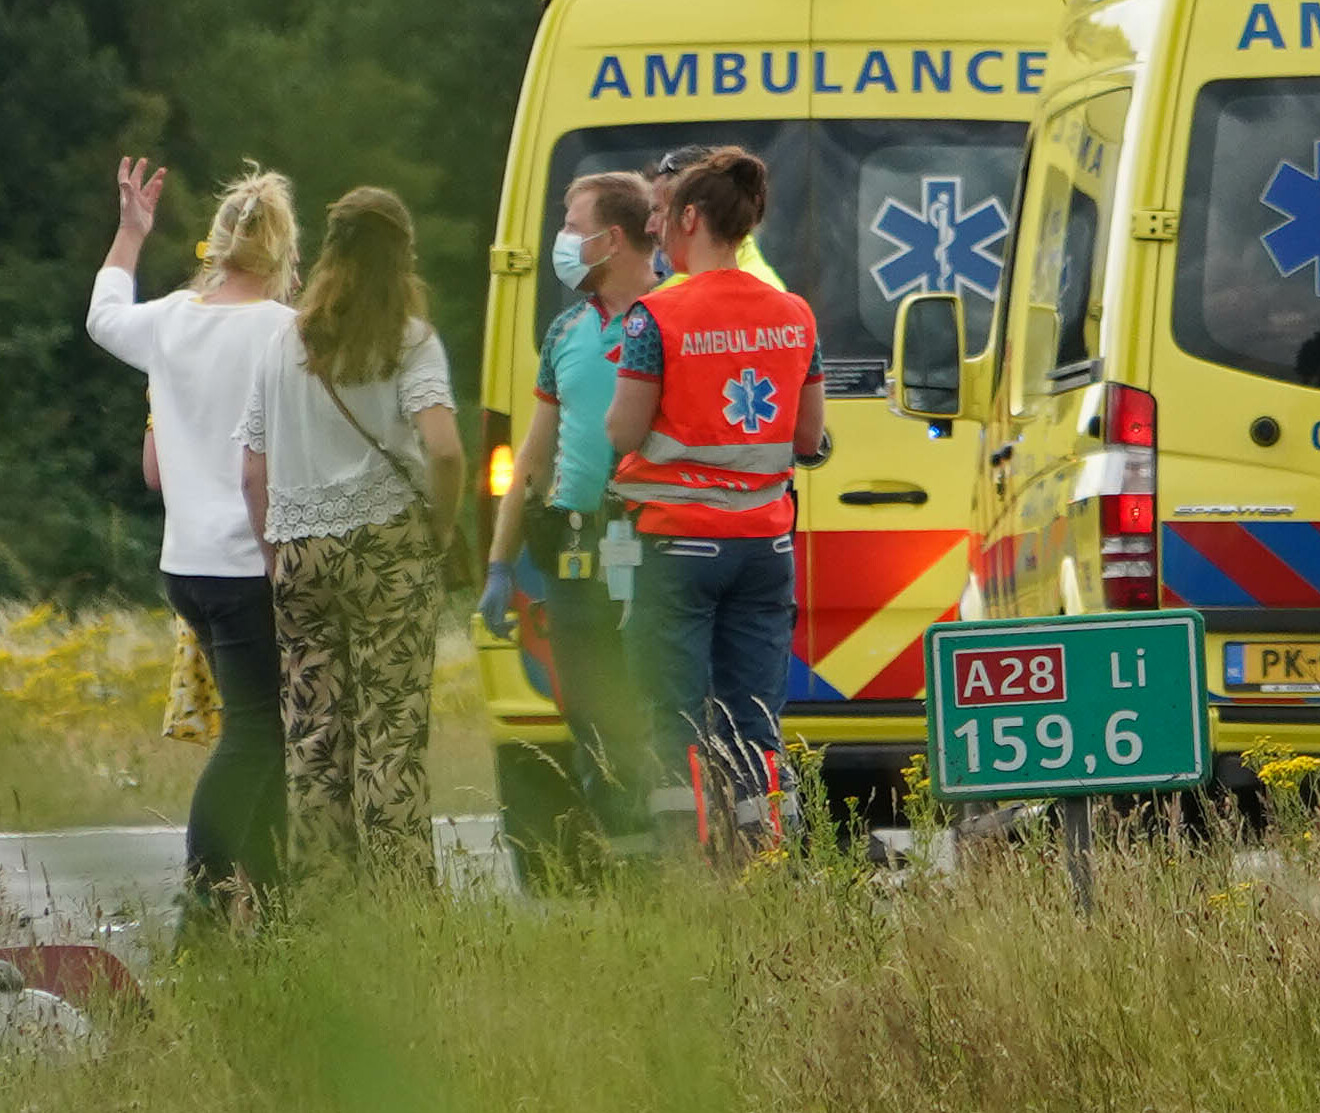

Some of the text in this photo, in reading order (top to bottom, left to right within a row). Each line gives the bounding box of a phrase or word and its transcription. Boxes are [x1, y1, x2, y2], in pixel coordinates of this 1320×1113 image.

[588, 49, 1048, 99] AMBULANCE
[680, 325, 807, 356] AMBULANCE
[963, 647, 1146, 698] A28 Li
[953, 709, 1143, 774] 159,6
